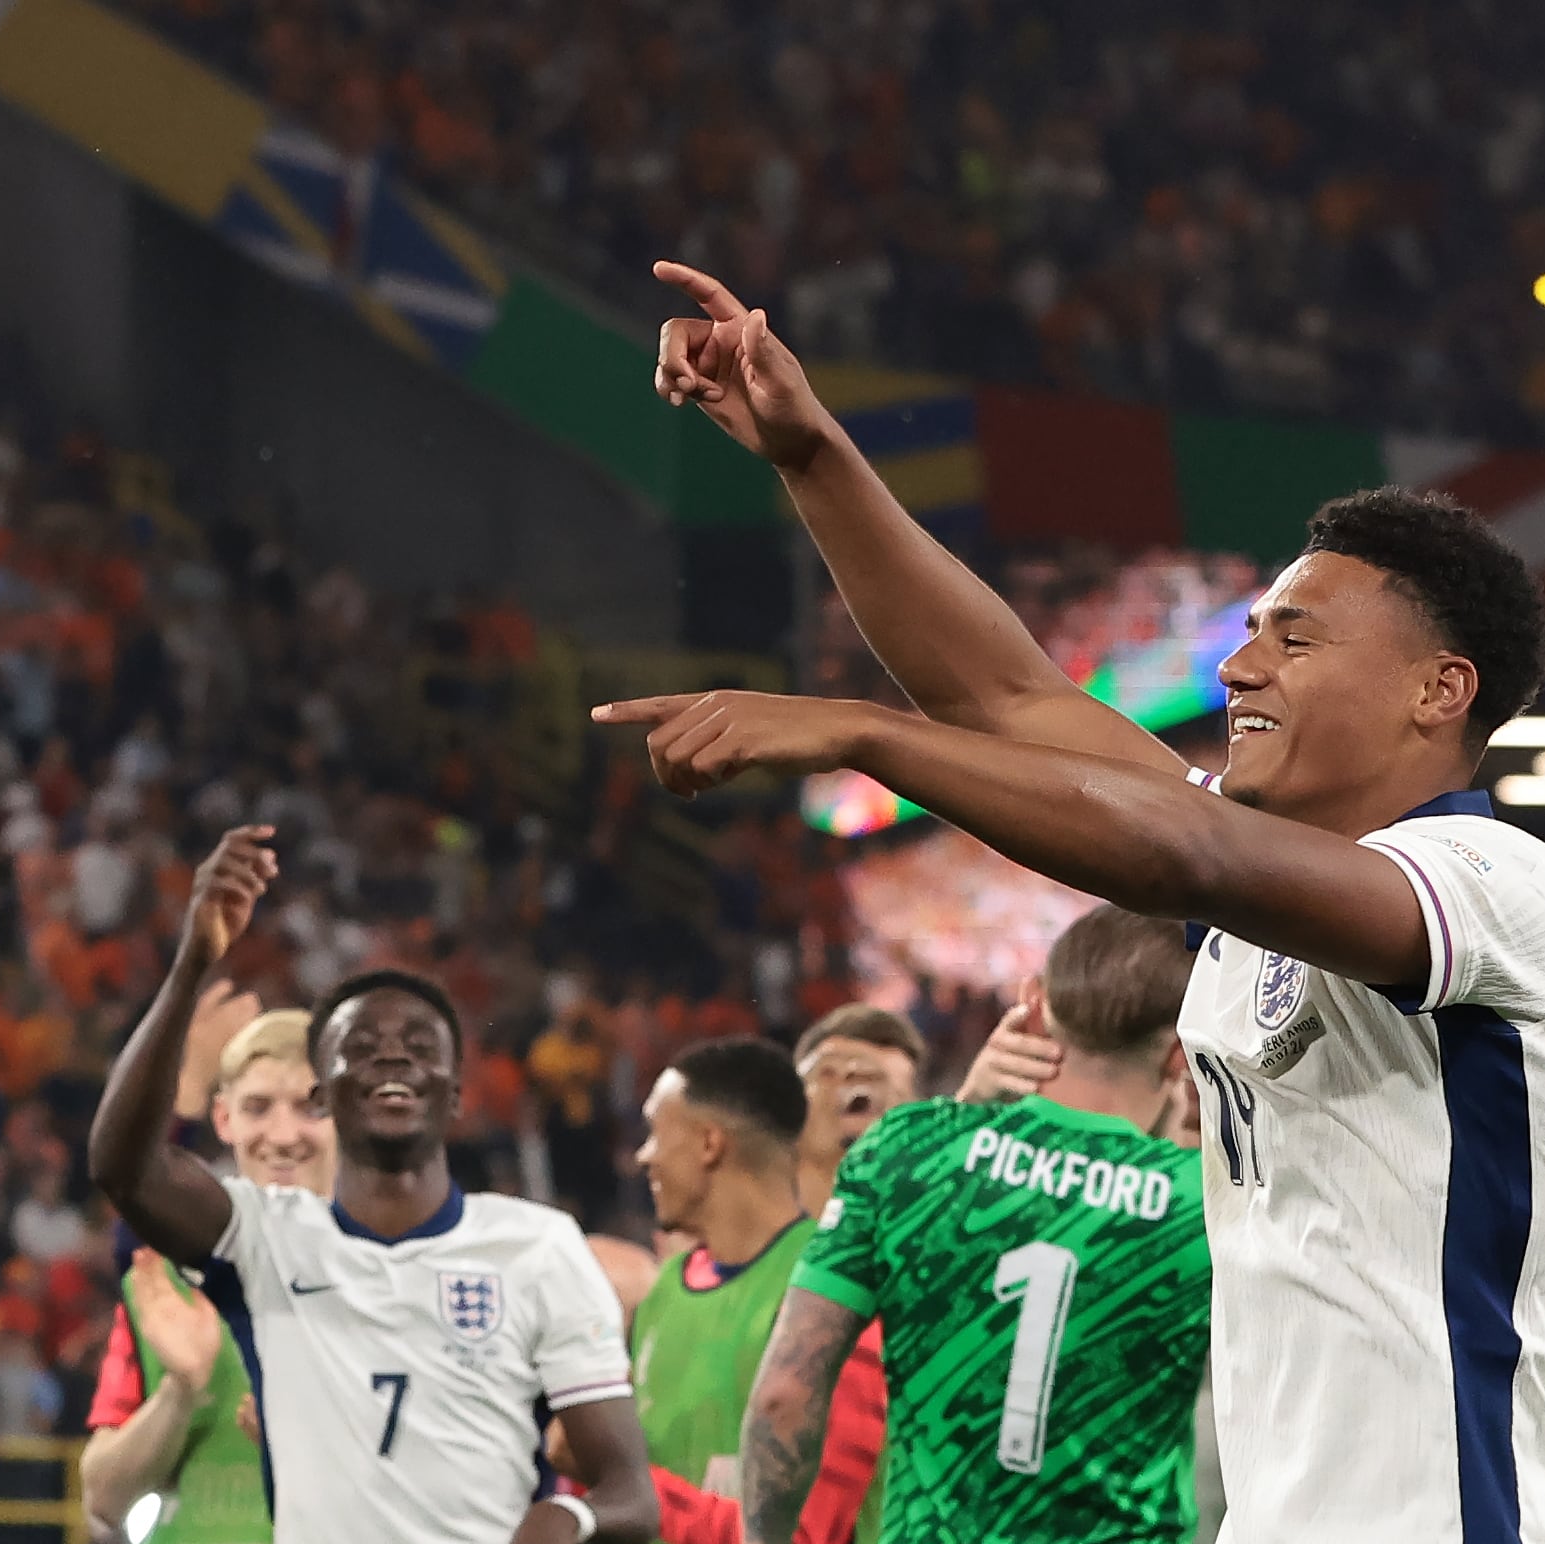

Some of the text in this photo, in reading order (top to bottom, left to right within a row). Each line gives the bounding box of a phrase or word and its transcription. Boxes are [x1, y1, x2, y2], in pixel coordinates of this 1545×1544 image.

[964, 1126, 1171, 1222] PICKFORD
[993, 1240, 1078, 1475] 1
[371, 1371, 410, 1457] 7
